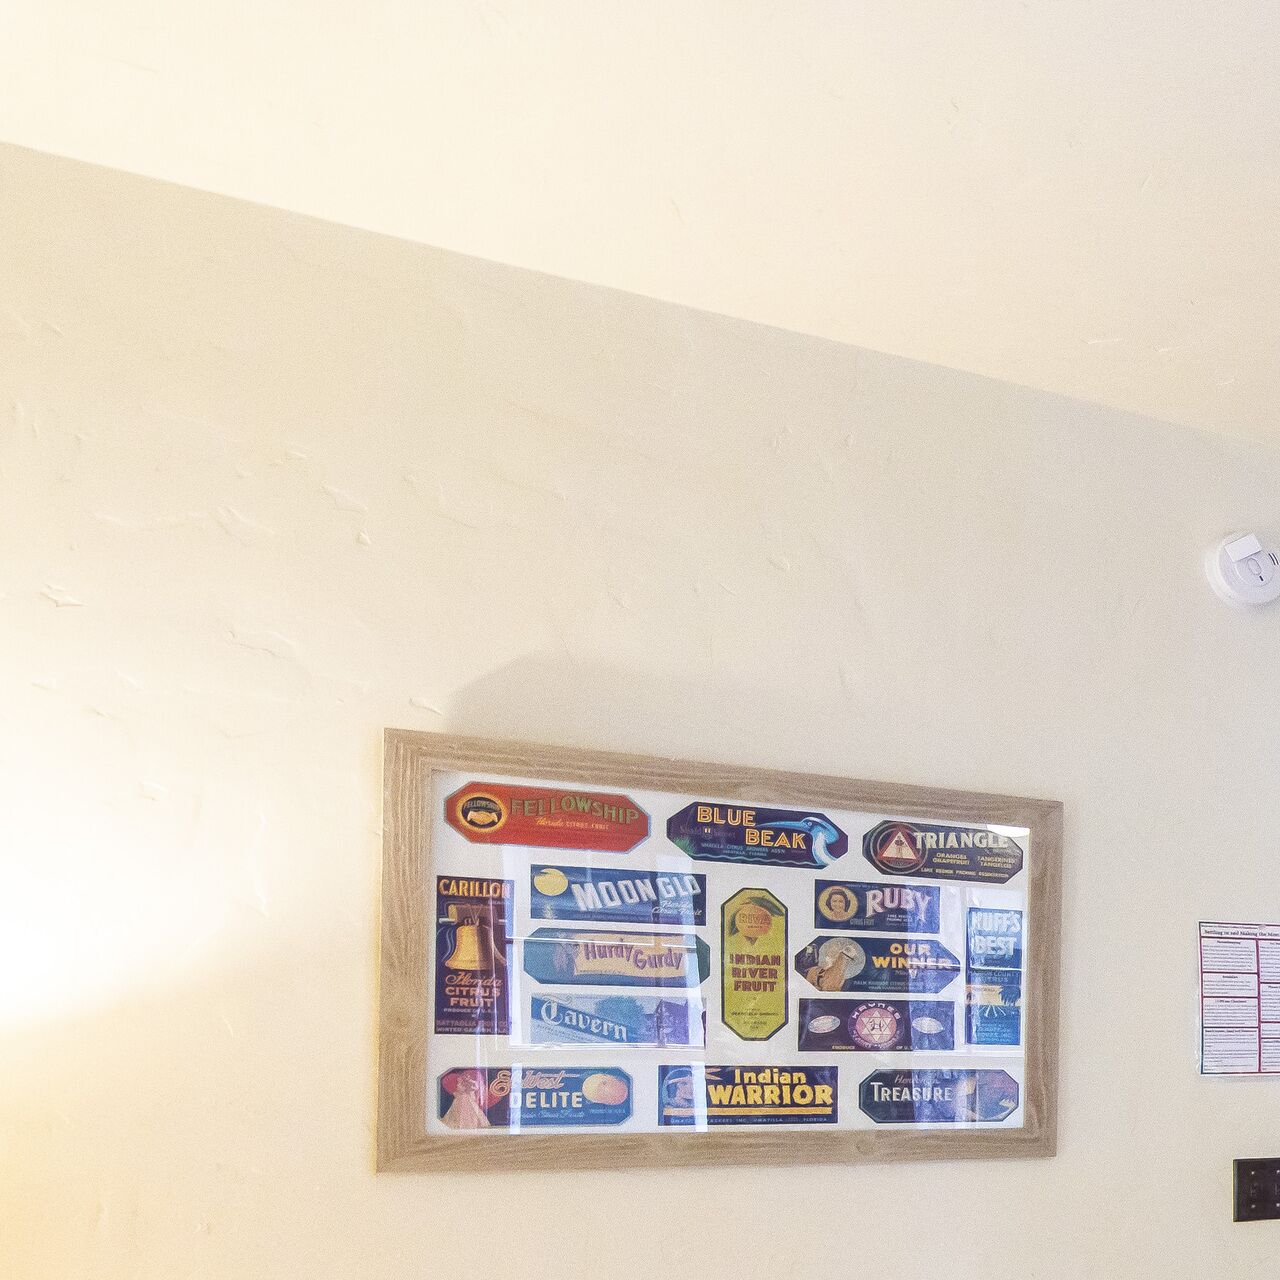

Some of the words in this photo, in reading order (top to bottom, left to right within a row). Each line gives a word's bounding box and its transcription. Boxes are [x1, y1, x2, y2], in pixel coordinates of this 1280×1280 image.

[510, 796, 641, 825] FELLOWSHIP
[697, 805, 756, 827] BLUE
[745, 828, 806, 850] BEAK
[914, 831, 1008, 850] TRIANGLE
[439, 879, 511, 899] CARILLON
[866, 887, 933, 921] RUBY
[738, 912, 772, 925] RIVA
[583, 938, 635, 963] Hurdy
[632, 948, 684, 971] Gurdy
[890, 943, 932, 956] OUR
[974, 936, 1017, 956] BEST
[729, 953, 781, 967] INDIAN
[872, 956, 952, 970] WINNER
[445, 971, 503, 987] Florida
[731, 967, 779, 980] RIVER
[445, 986, 501, 997] CITRUS
[733, 980, 777, 993] FRUIT
[450, 997, 494, 1008] FRUIT
[851, 1003, 902, 1020] HAYNES
[540, 999, 628, 1042] Tavern
[734, 1068, 807, 1084] Indian
[509, 1091, 584, 1109] DELITE
[707, 1084, 834, 1106] WARRIOR
[871, 1082, 953, 1102] TREASURE
